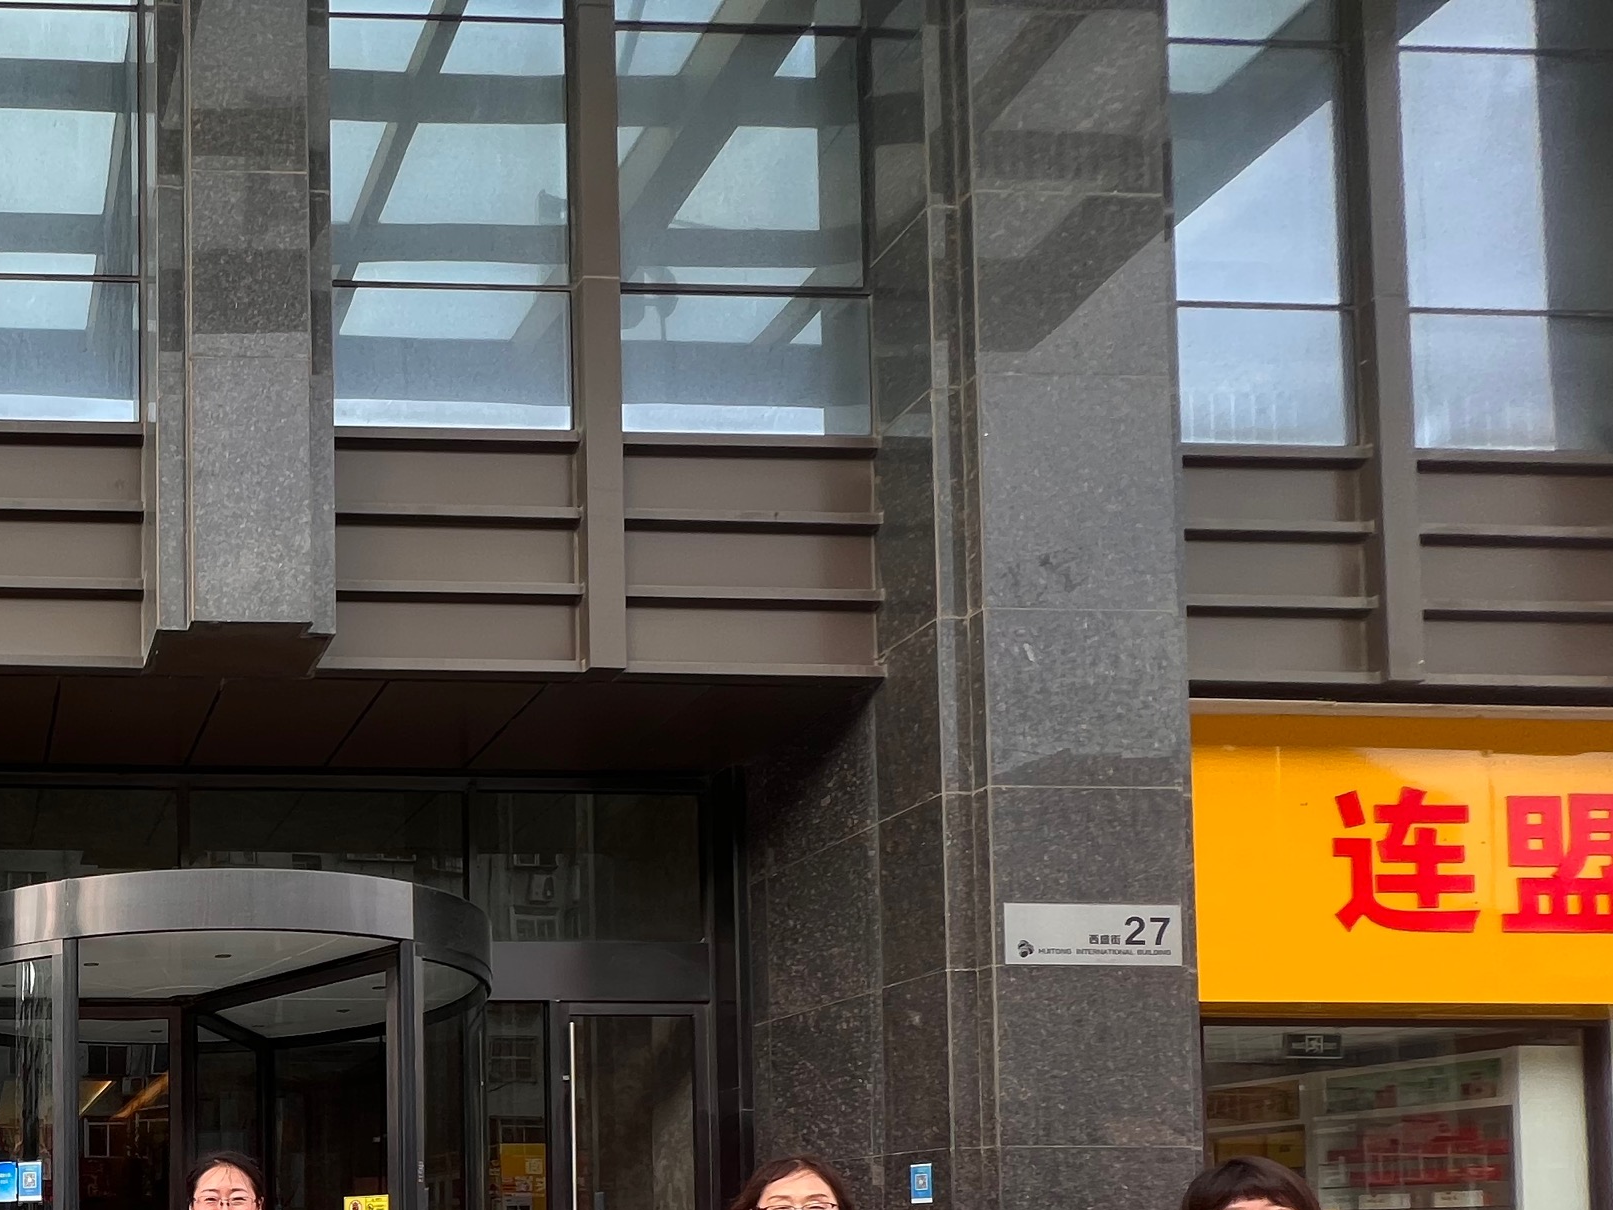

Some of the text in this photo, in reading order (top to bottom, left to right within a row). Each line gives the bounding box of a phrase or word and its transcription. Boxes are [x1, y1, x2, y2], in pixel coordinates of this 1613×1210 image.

[1331, 785, 1613, 934] 连盟
[1124, 916, 1171, 946] 27
[1075, 948, 1134, 956] INTERNATIONAL
